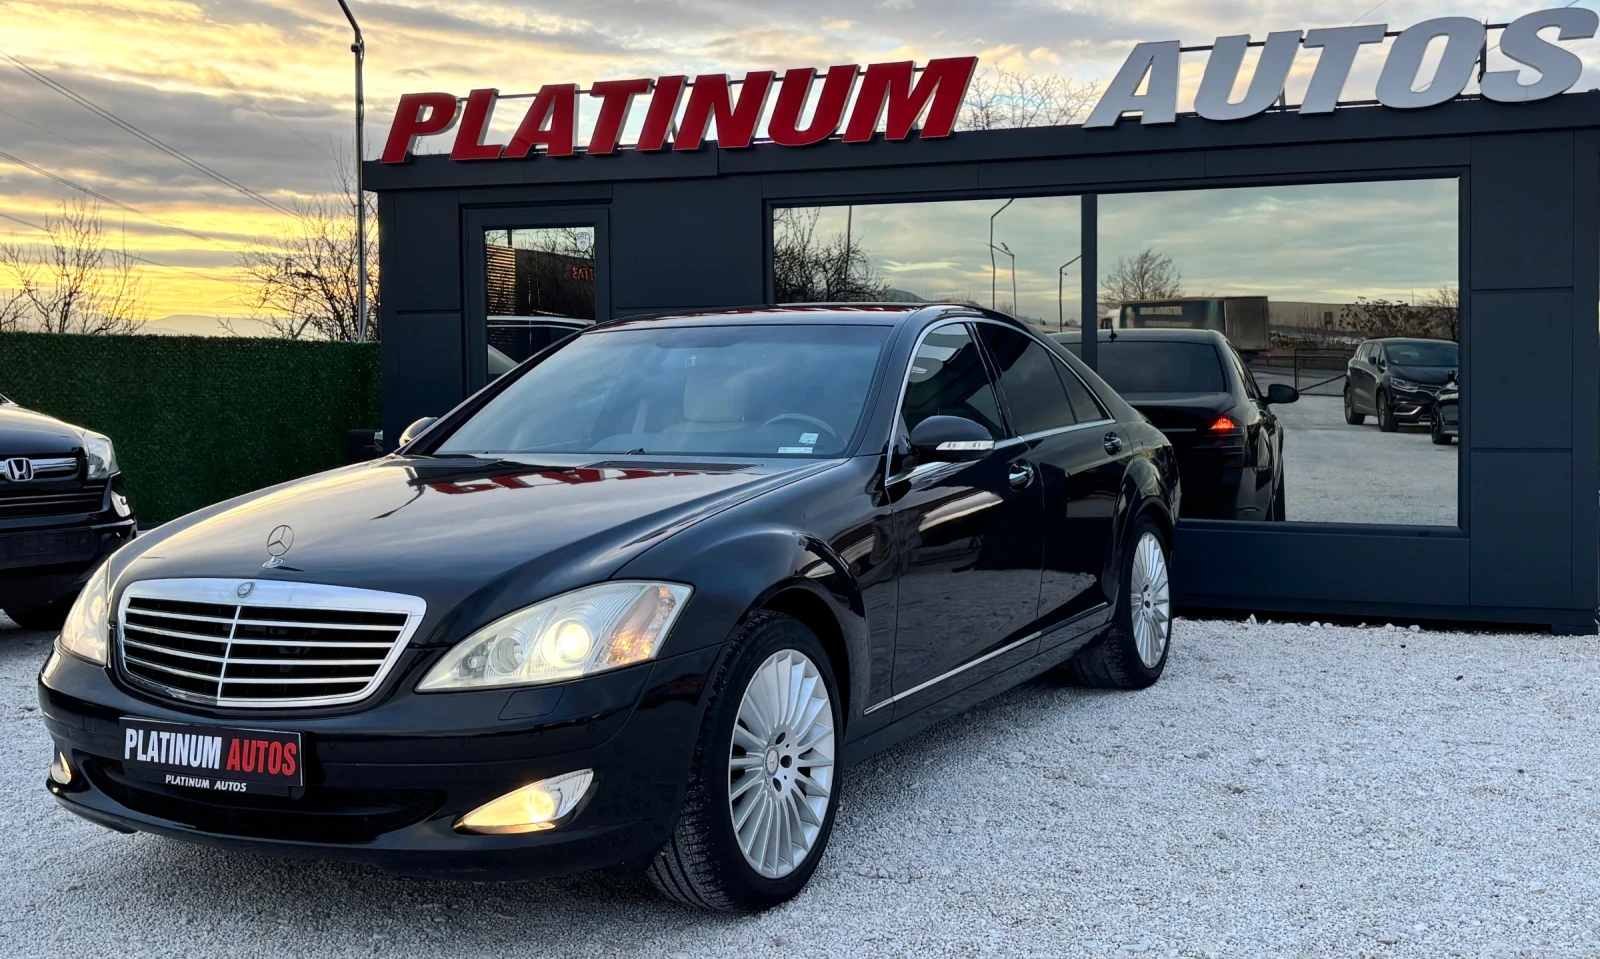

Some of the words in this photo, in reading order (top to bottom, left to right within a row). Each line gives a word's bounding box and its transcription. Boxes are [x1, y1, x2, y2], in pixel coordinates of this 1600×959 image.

[380, 56, 979, 164] PLATINUM
[1082, 7, 1600, 129] AUTOS
[124, 728, 222, 769] PLATINUM
[226, 738, 297, 776] AUTOS
[165, 774, 210, 789] PLATINUM
[214, 780, 247, 792] AUTOS
